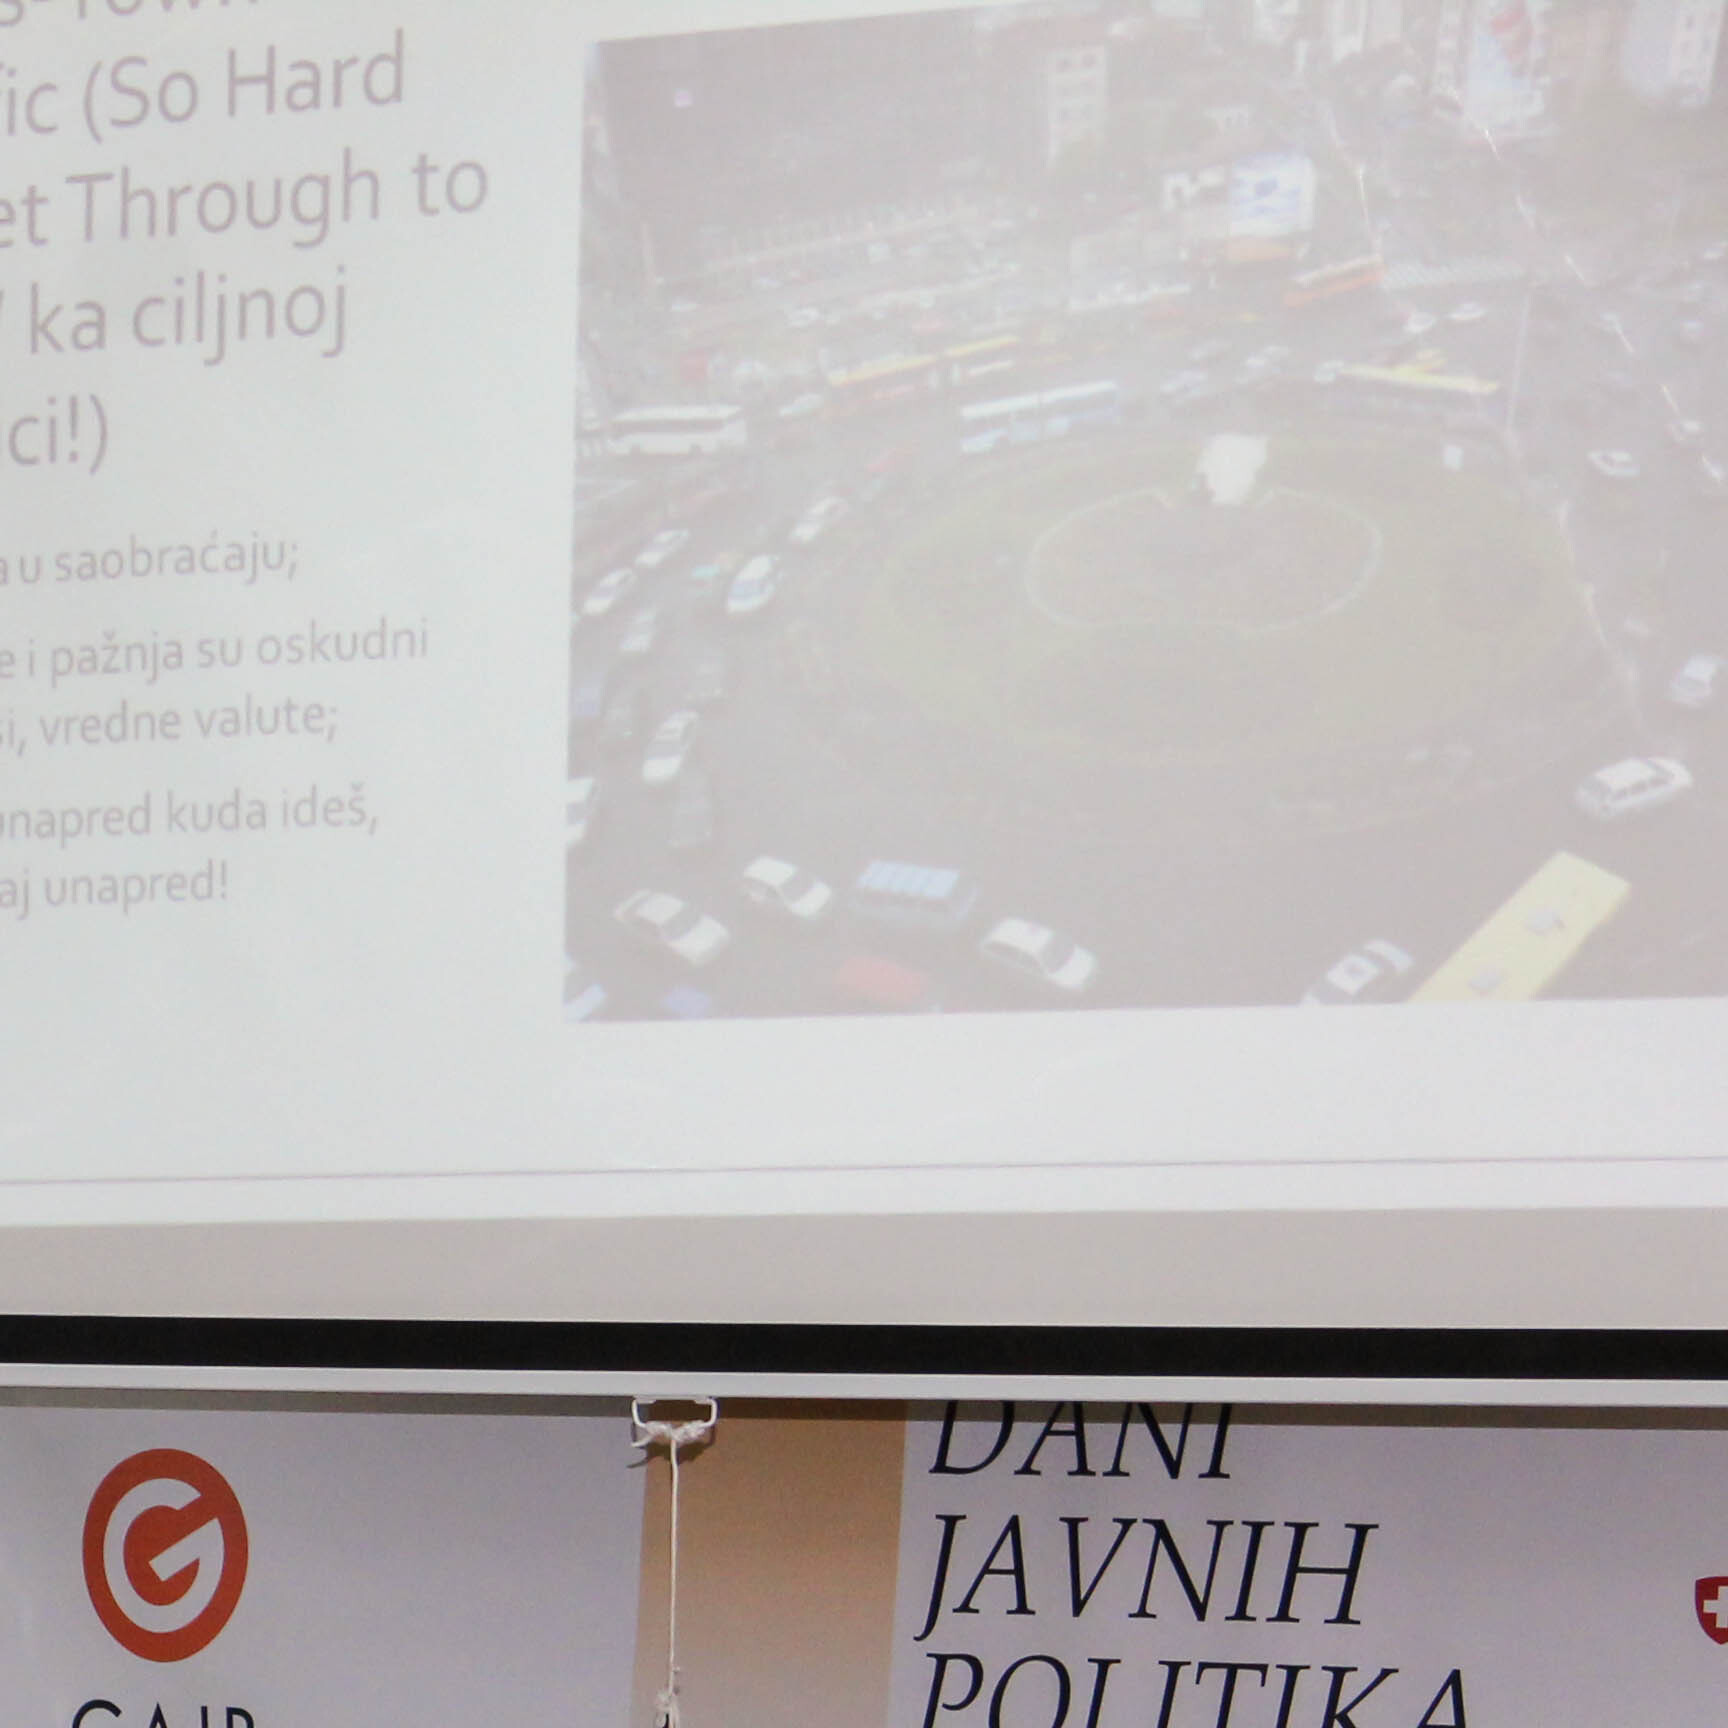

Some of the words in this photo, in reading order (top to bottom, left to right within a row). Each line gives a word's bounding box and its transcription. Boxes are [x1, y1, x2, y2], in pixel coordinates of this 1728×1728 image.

[83, 57, 199, 143] (So
[226, 27, 404, 118] Hard
[65, 147, 381, 249] Through
[412, 154, 488, 216] to
[29, 282, 107, 355] ka
[132, 265, 346, 366] ciljnoj
[19, 553, 42, 585] u
[55, 529, 299, 584] saobraćaju;
[26, 638, 36, 677] i
[49, 628, 184, 687] pažnja
[197, 637, 243, 668] su
[256, 616, 429, 666] oskudni
[40, 700, 182, 746] vredne
[194, 692, 338, 742] valute;
[166, 788, 267, 835] kuda
[281, 781, 379, 836] ideš,
[47, 859, 229, 913] unapred!
[928, 1403, 1233, 1480] DANI
[913, 1514, 1379, 1641] JAVNIH
